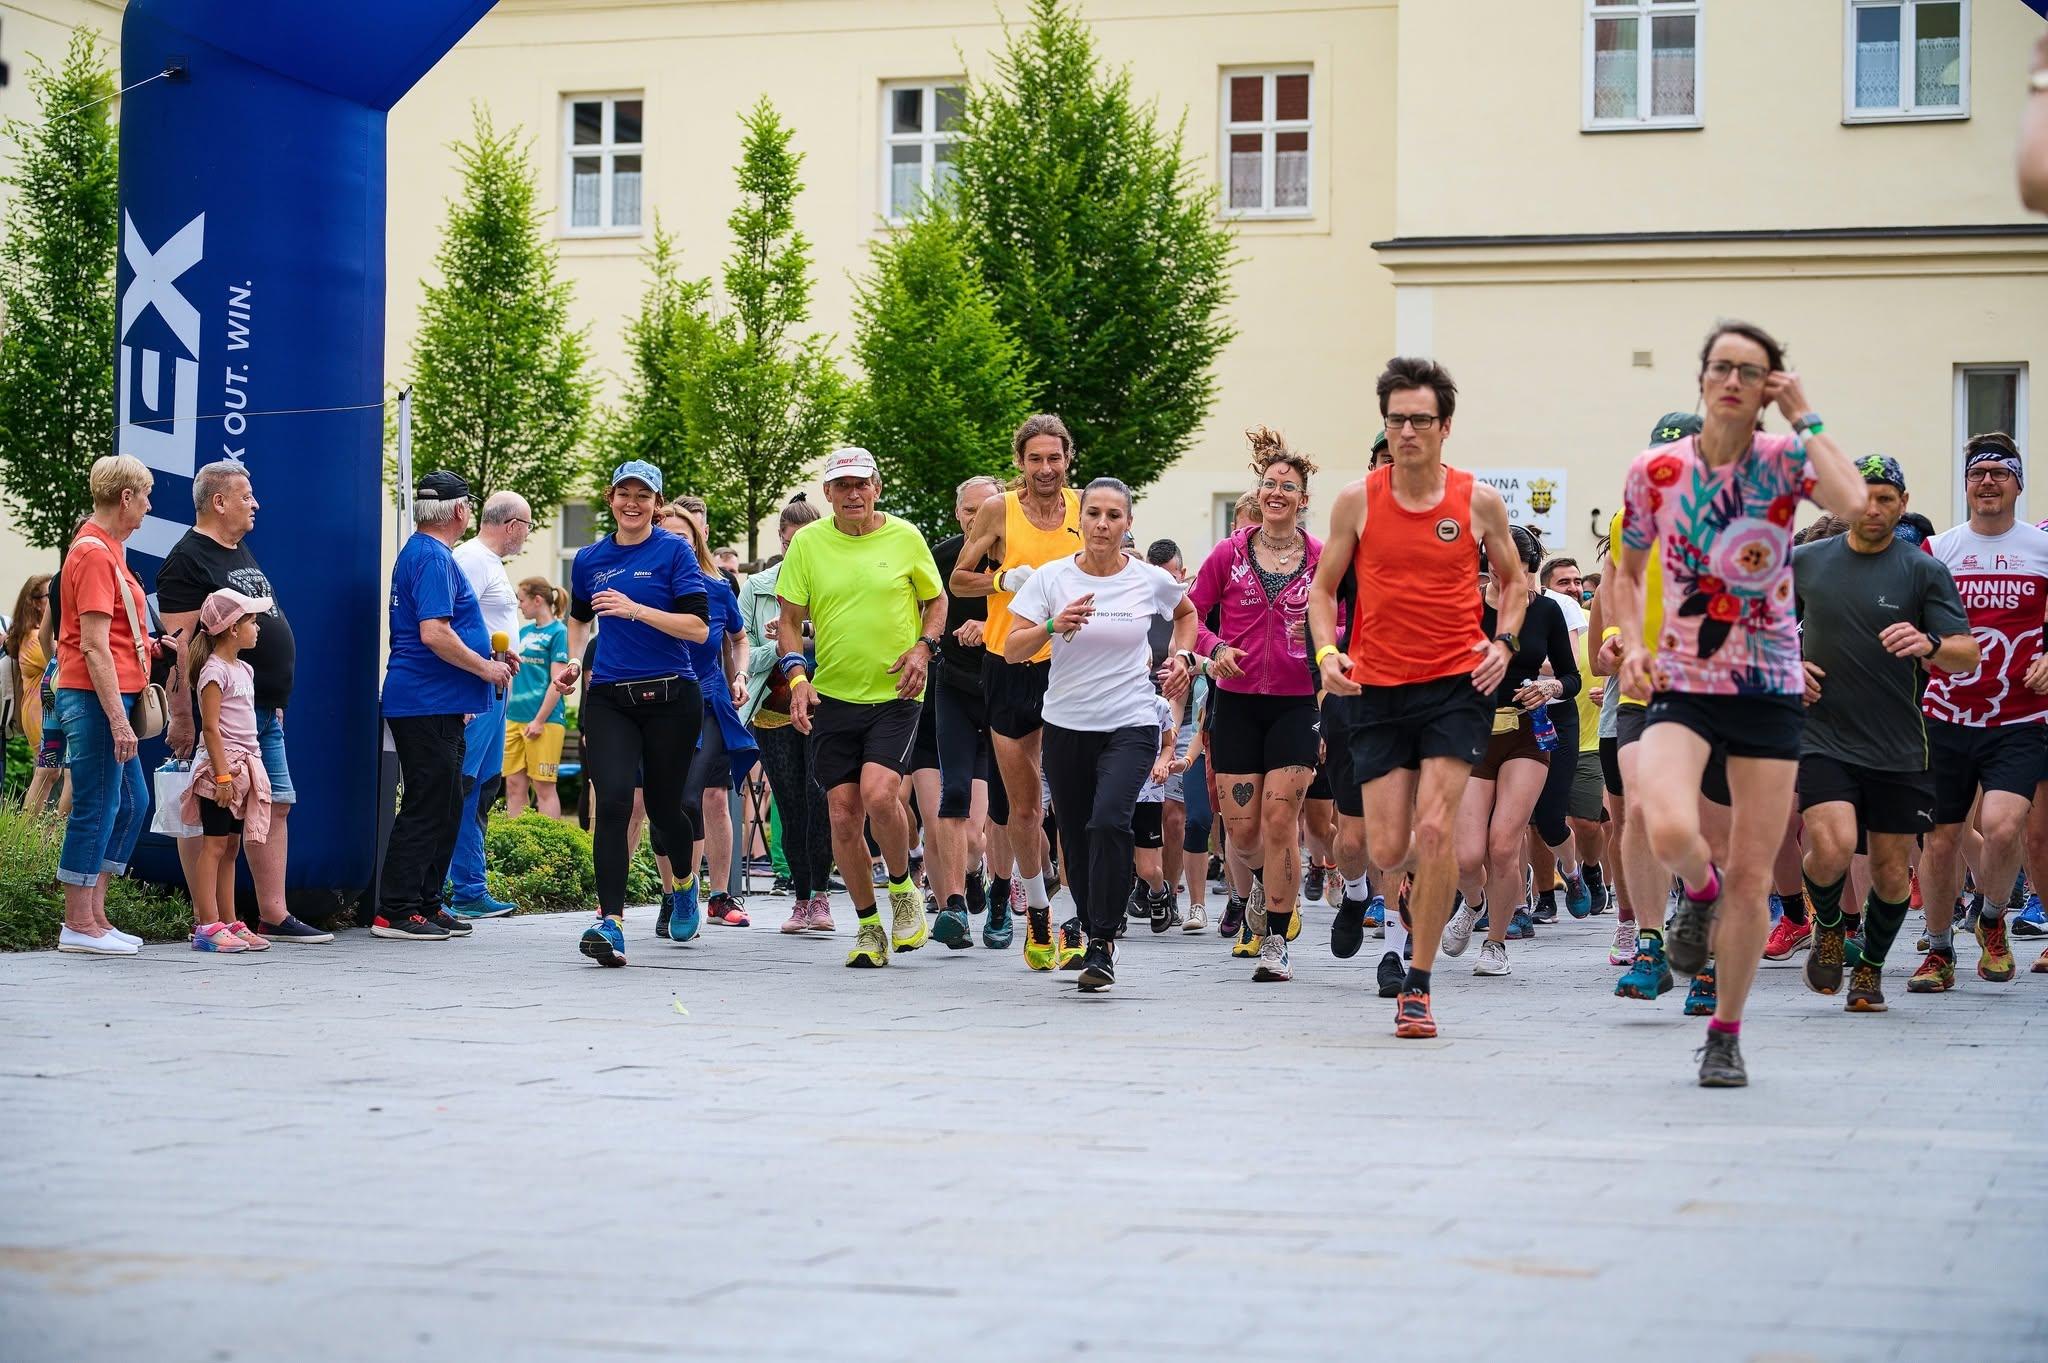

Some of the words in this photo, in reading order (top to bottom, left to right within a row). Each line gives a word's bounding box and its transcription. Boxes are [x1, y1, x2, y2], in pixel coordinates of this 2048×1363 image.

[227, 280, 252, 352] WIN.
[223, 364, 249, 436] OUT.
[1955, 580, 2035, 596] UNNING
[1240, 597, 1262, 607] BEACH
[1963, 594, 2019, 609] IONS
